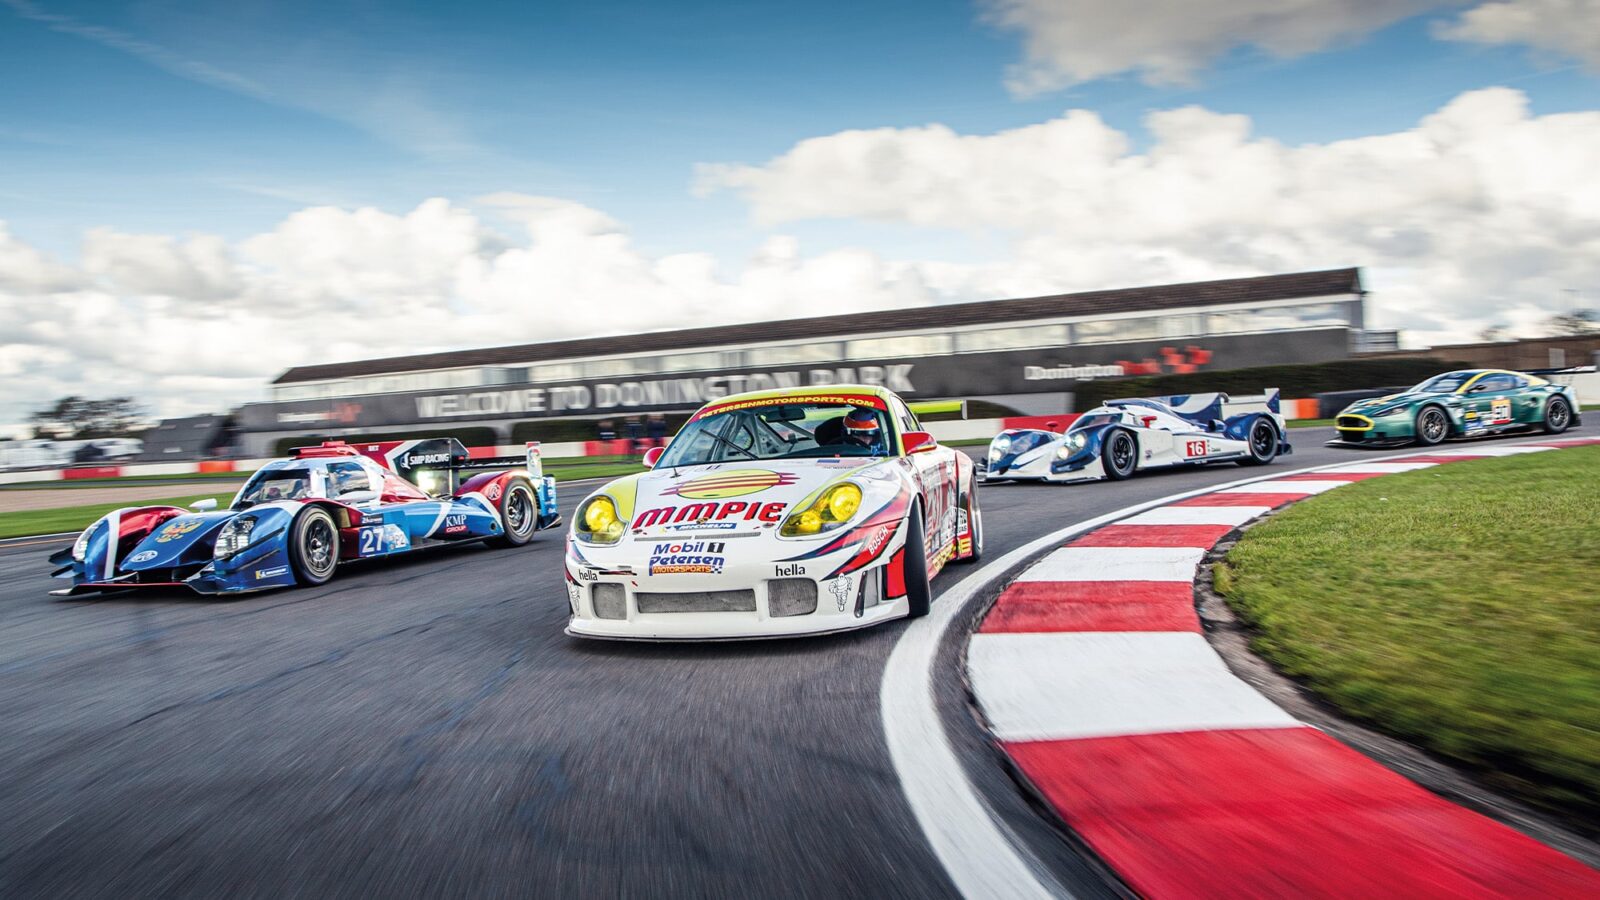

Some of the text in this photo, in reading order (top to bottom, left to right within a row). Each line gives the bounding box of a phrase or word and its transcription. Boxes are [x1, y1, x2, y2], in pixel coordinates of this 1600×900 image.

[414, 364, 915, 418] WELCOME TO DONINGTON PARK
[699, 395, 876, 419] PETERSENMOTORSPORTS.COM
[1187, 441, 1205, 456] 16
[425, 453, 450, 463] RACING
[446, 515, 467, 527] KMP
[446, 525, 467, 533] GROUP
[361, 528, 385, 553] 27
[868, 525, 889, 555] BOSCH
[653, 542, 723, 555] Mobil 1
[649, 555, 725, 576] Petersen
[652, 565, 712, 575] MOTORSPORTS
[775, 564, 806, 577] hella
[578, 569, 598, 581] hella
